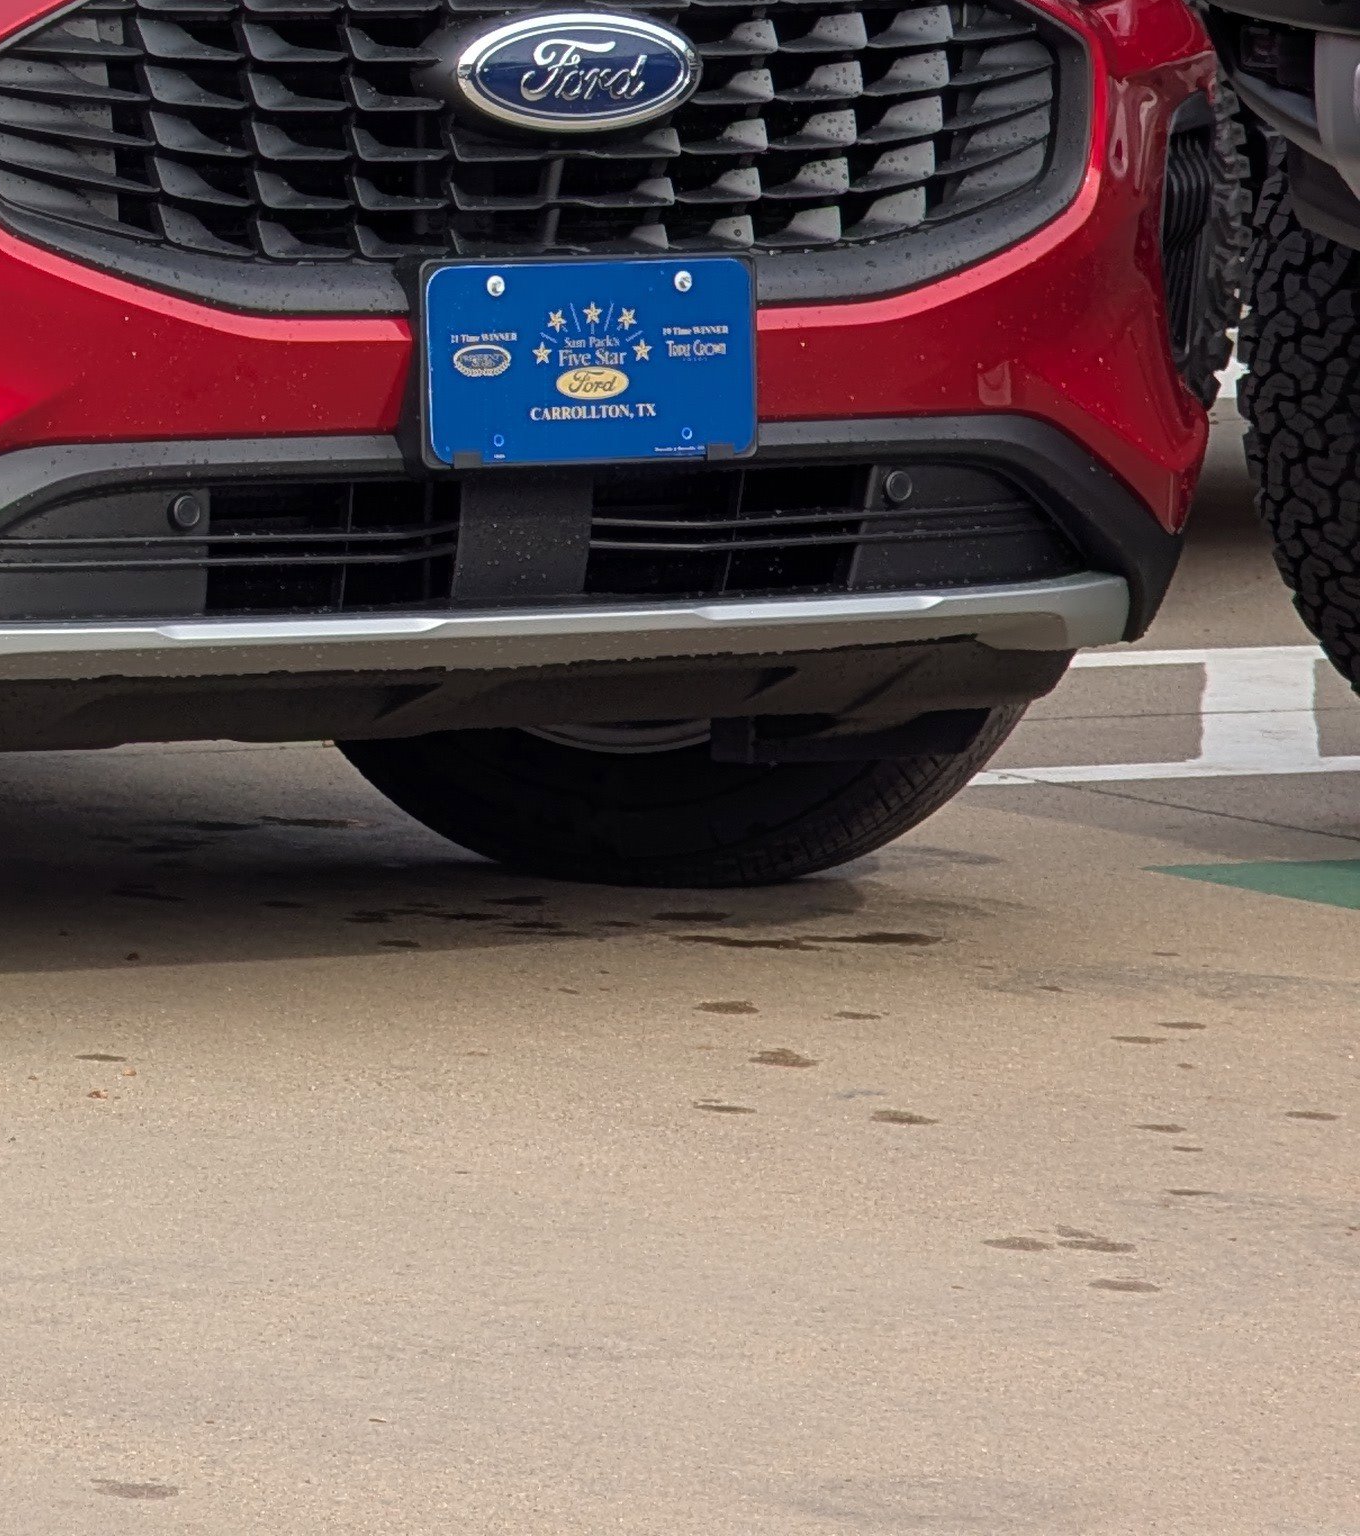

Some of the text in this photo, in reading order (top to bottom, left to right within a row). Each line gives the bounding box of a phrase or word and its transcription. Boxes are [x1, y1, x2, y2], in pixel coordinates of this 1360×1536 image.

[520, 37, 648, 102] Ford
[481, 331, 518, 342] WINNER
[563, 334, 621, 349] Sam Pack's
[558, 348, 627, 366] Five Star
[567, 370, 617, 394] Ford
[529, 403, 657, 422] CARROLLTON, TX
